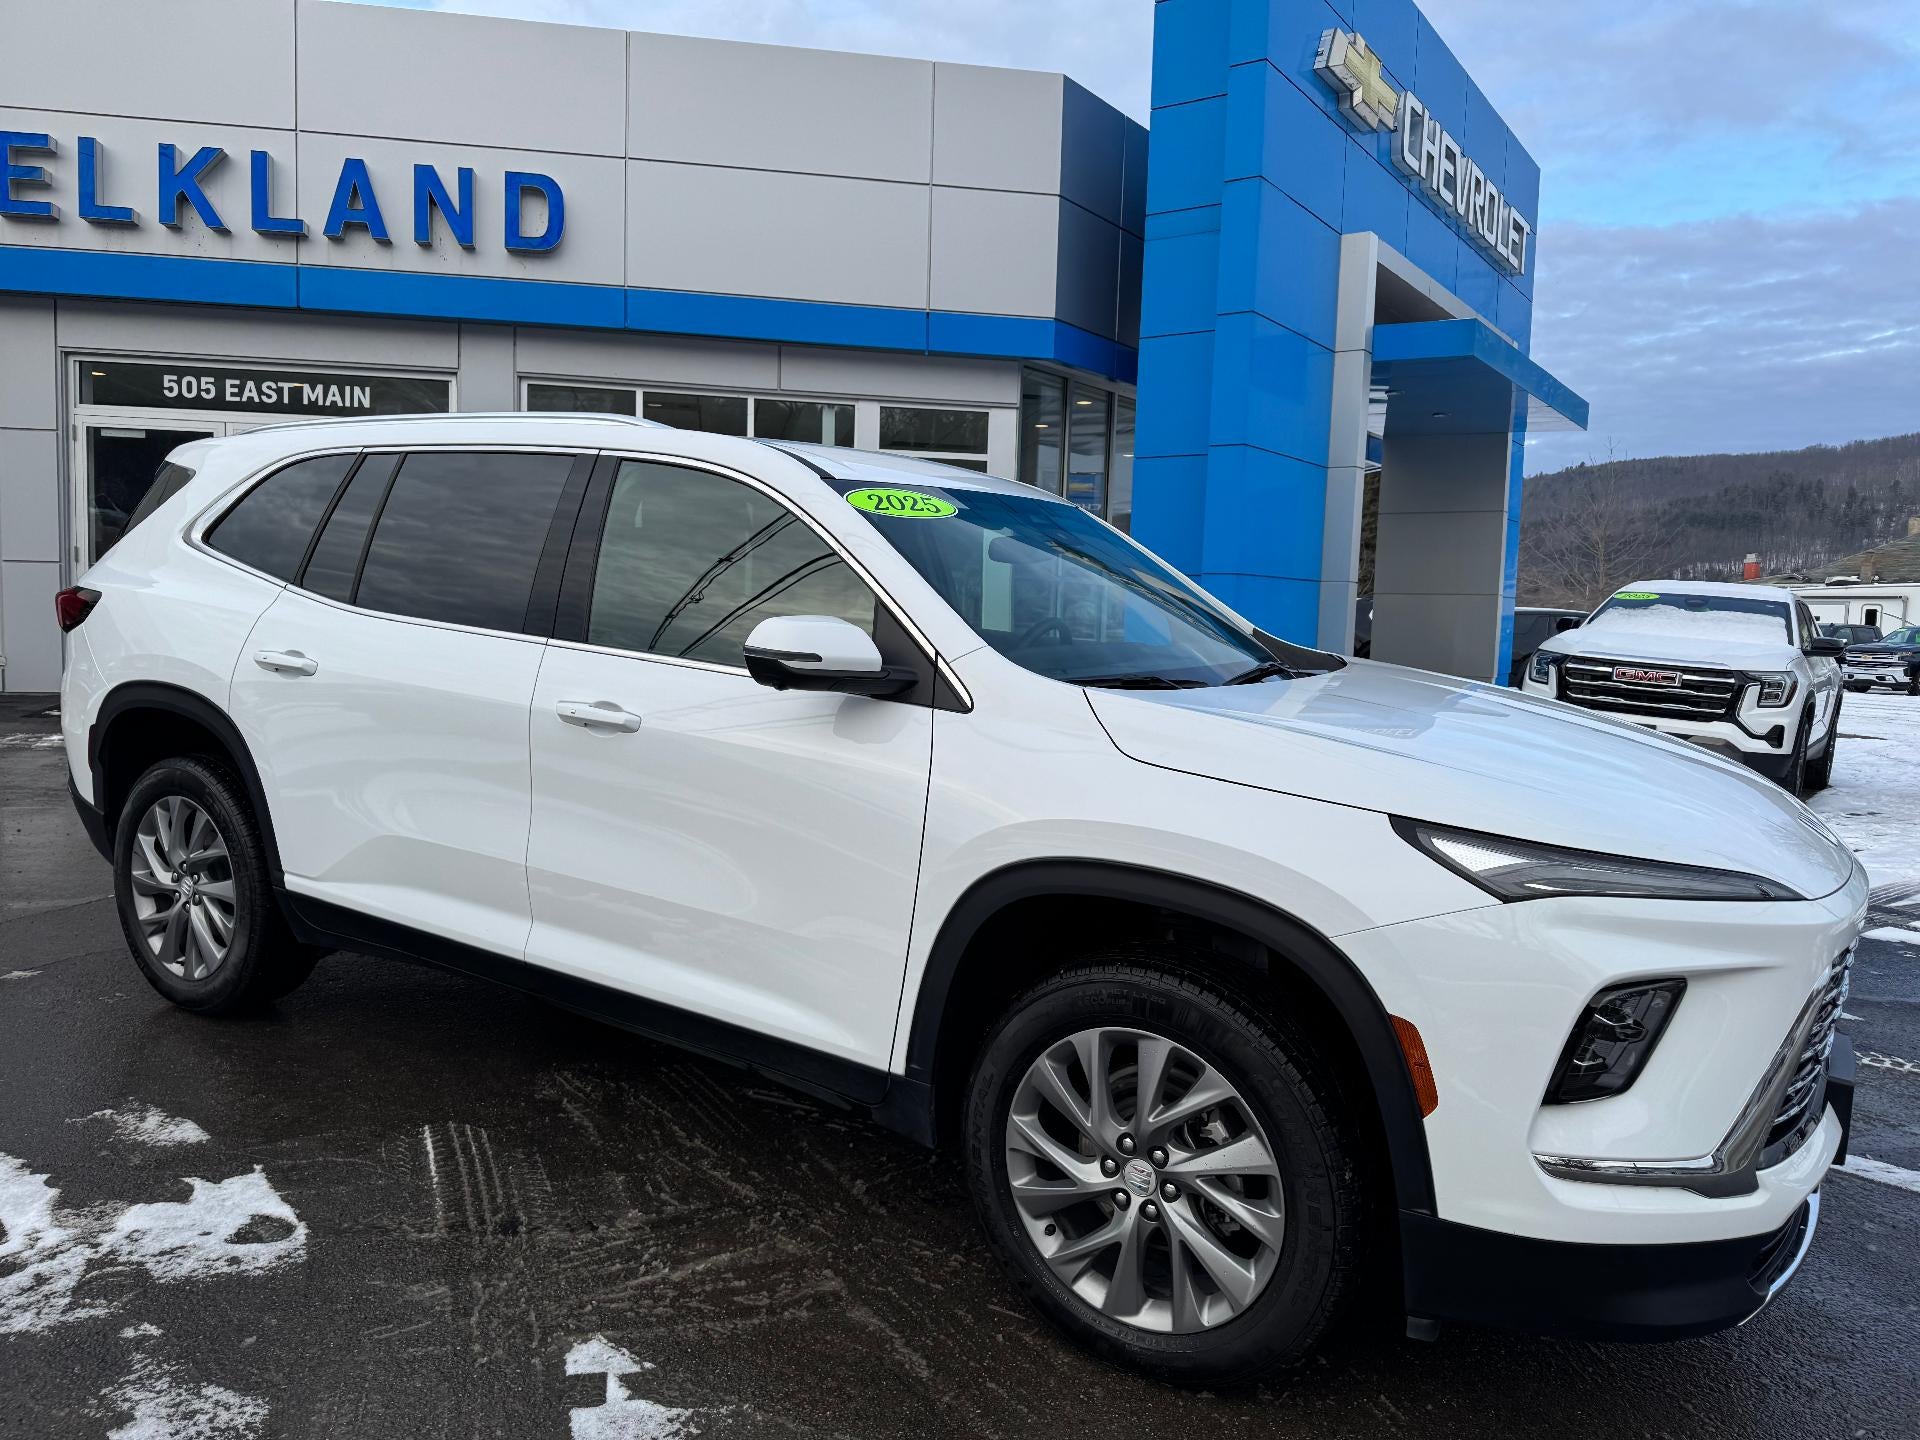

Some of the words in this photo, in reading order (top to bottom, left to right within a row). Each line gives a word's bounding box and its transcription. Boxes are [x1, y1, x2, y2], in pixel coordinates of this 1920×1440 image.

[0, 130, 566, 254] ELKLAND
[1393, 90, 1531, 276] CHEVROLET
[162, 374, 216, 399] 505
[225, 378, 294, 404] EAST
[302, 383, 371, 408] MAIN
[867, 493, 941, 514] 2025
[1615, 668, 1677, 684] GMC
